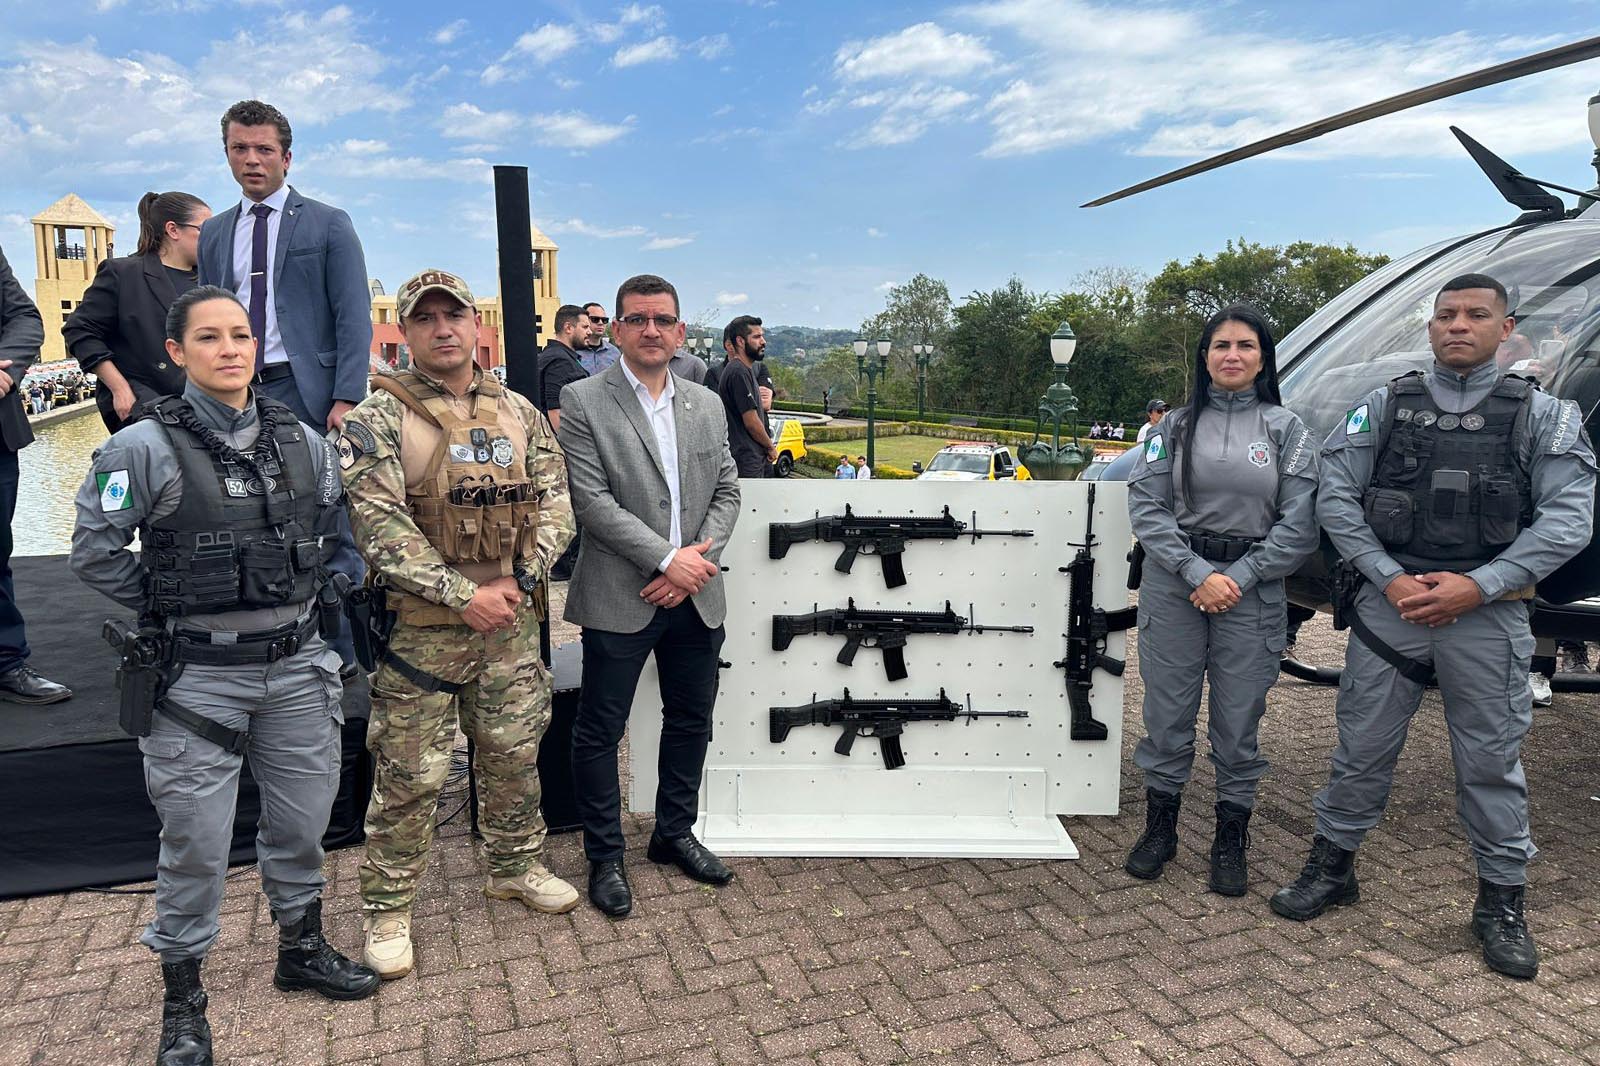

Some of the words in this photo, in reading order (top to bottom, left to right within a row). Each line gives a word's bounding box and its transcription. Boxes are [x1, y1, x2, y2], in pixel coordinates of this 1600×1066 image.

[1397, 408, 1412, 419] 67
[1552, 423, 1567, 452] POLÍCIA
[229, 481, 244, 493] 52
[323, 470, 333, 503] POLÍCIA
